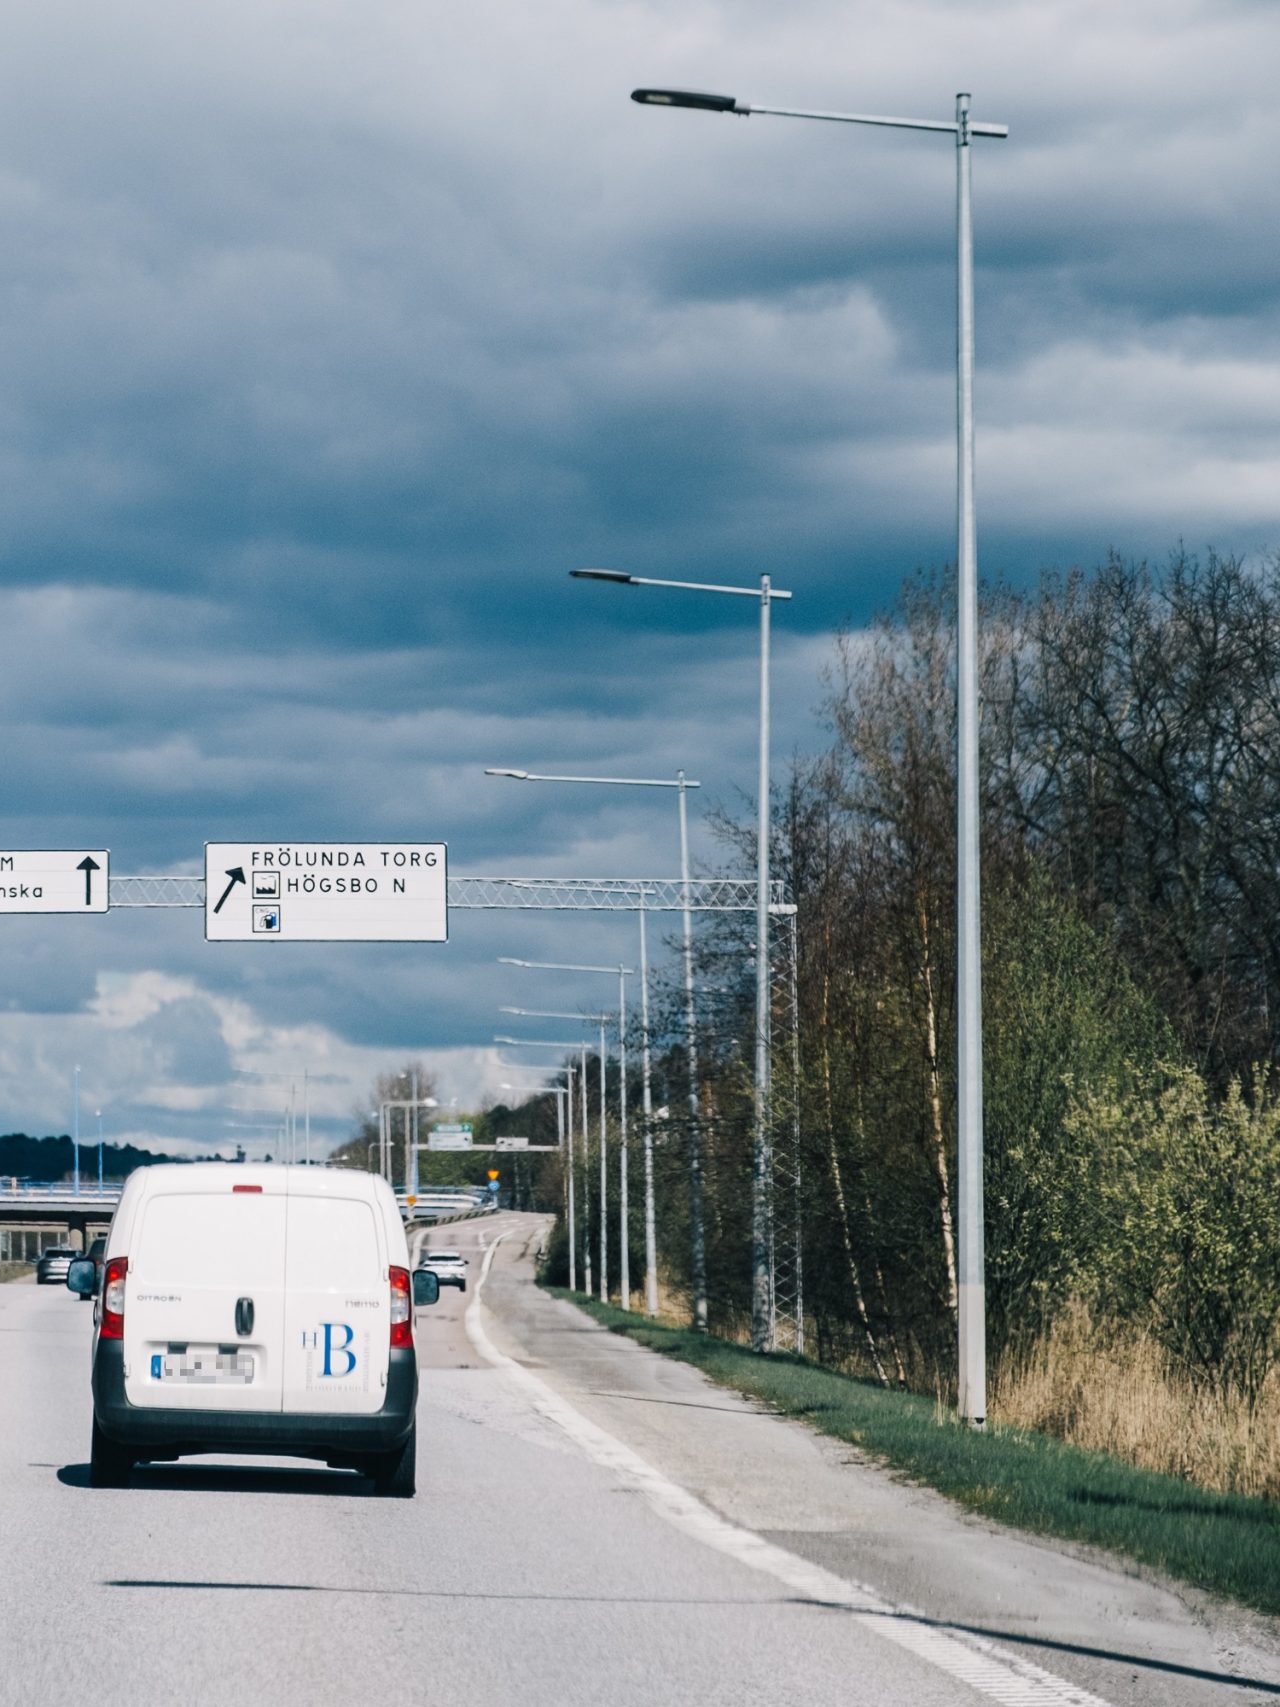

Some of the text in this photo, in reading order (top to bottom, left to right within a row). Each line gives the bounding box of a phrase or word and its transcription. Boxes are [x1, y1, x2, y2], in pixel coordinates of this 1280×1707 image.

[251, 848, 438, 867] FRÖLUNDA TORG
[286, 874, 406, 893] HÖGSBO N
